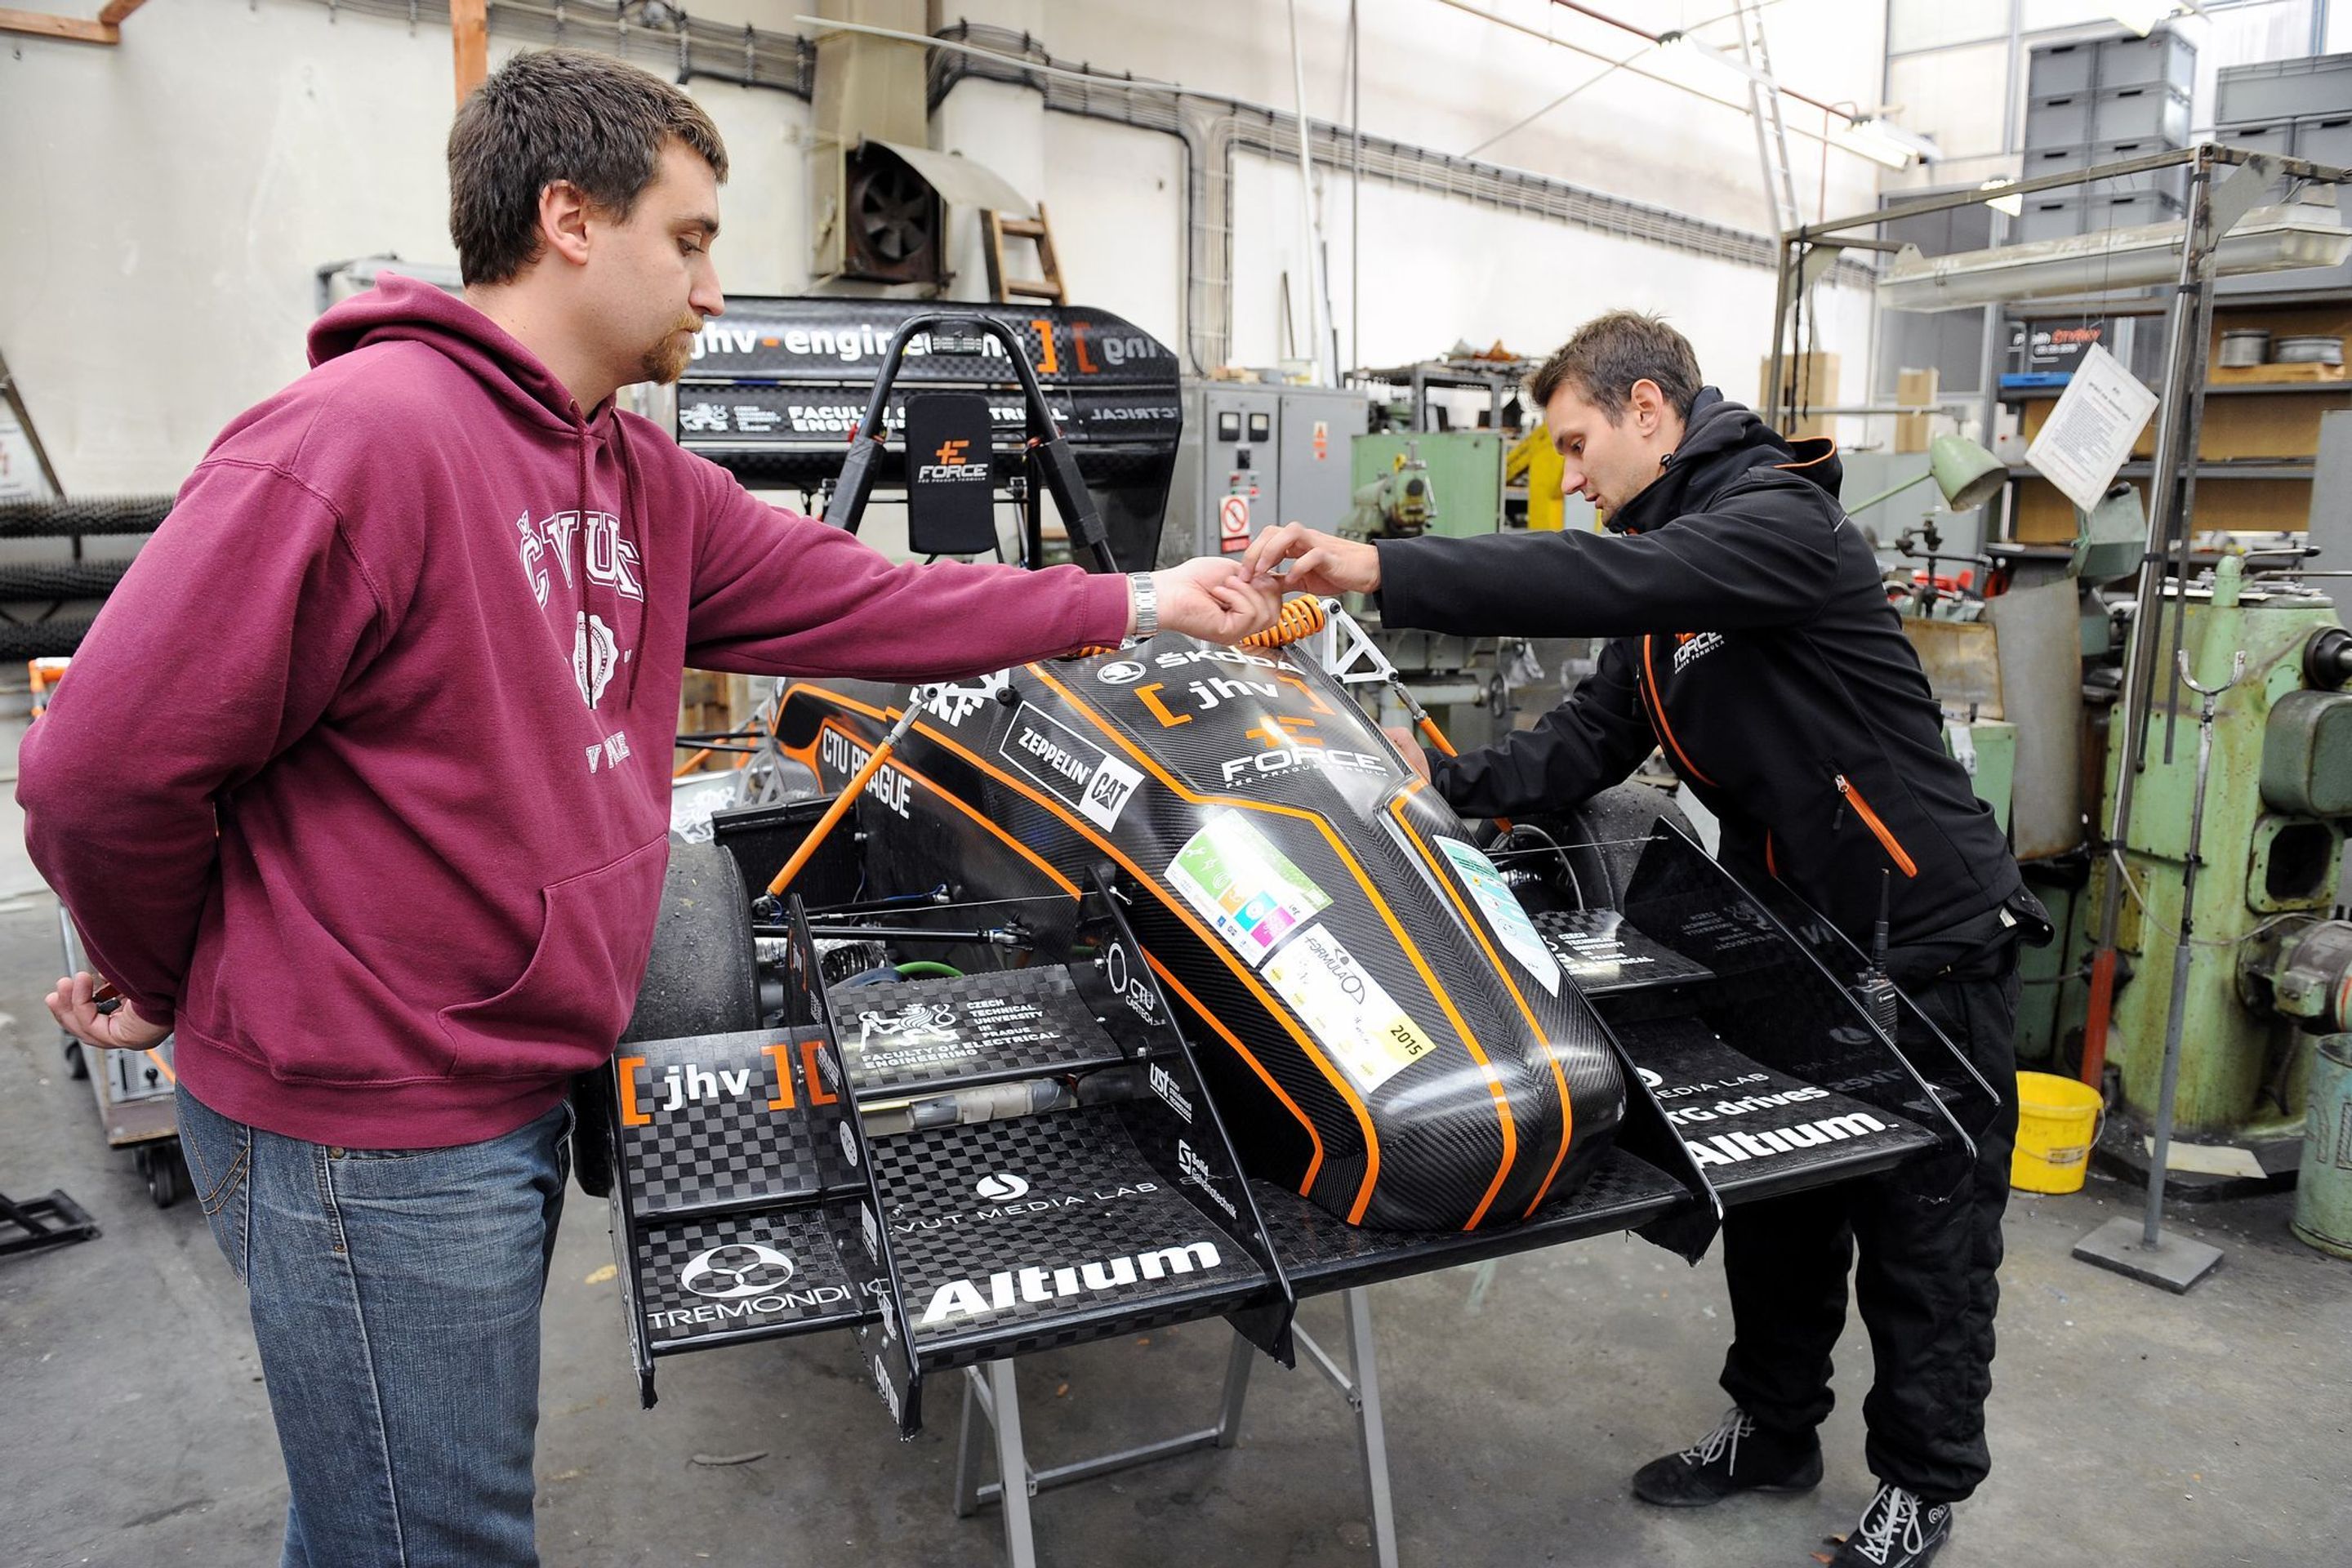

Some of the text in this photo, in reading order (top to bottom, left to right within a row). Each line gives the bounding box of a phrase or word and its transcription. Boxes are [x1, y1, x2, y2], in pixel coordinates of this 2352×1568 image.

[918, 464, 988, 479] FORCE
[1673, 631, 1722, 669] FORCE
[822, 727, 849, 774] CTU
[1221, 746, 1388, 783] FORCE
[1091, 772, 1129, 812] CAT
[966, 999, 1005, 1009] CZECH
[1130, 978, 1154, 1011] CTU
[969, 1004, 1036, 1018] TECHNICAL
[973, 1010, 1044, 1024] UNIVERSITY
[862, 1031, 1061, 1062] FACULTY OF ELECTRICAL
[982, 1027, 1031, 1038] PRAGUE
[1391, 1024, 1423, 1056] 2015
[864, 1049, 978, 1069] ENGINEERING
[1718, 1072, 1771, 1088] LAB
[1192, 1152, 1209, 1177] Solid
[978, 1196, 1085, 1220] MEDIA
[1094, 1182, 1159, 1200] LAB
[920, 1241, 1222, 1324] Altium
[646, 1284, 853, 1330] TREMONDI
